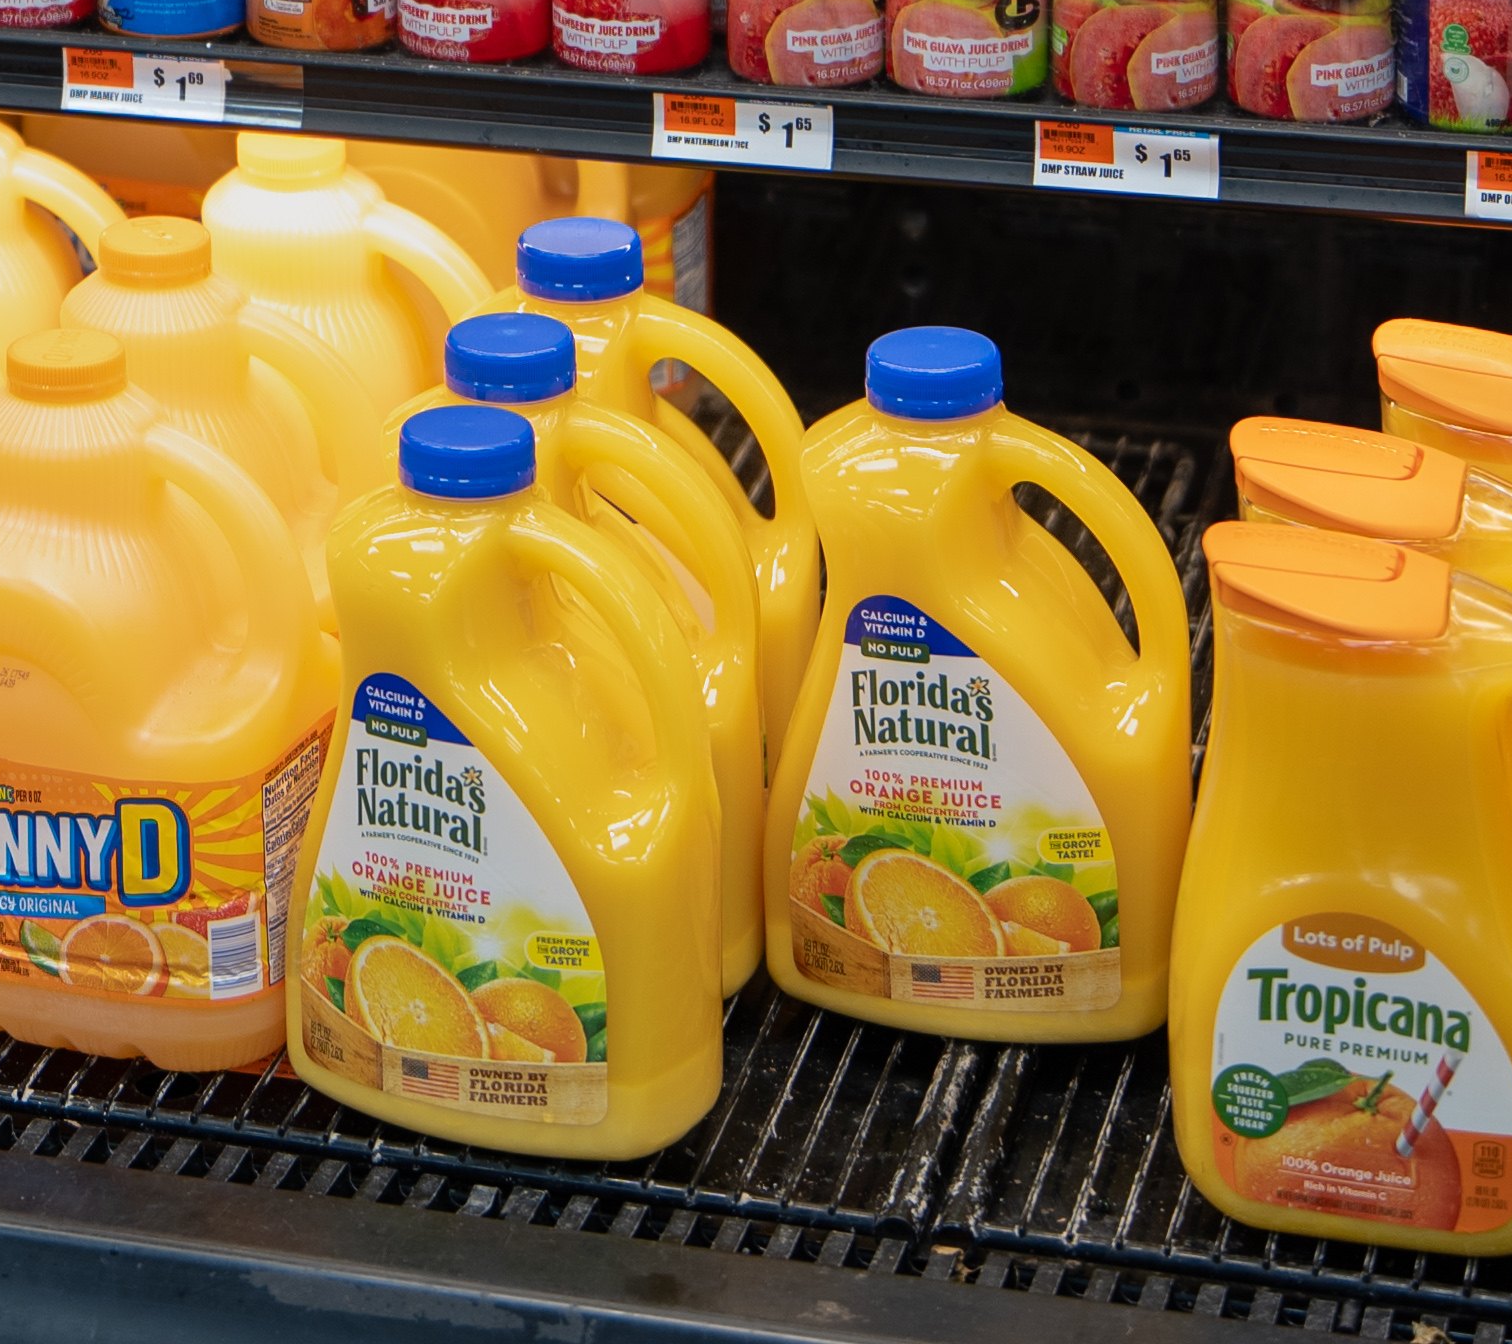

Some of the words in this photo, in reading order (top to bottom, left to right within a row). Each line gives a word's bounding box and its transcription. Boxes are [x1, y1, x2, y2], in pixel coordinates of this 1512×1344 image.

[70, 88, 84, 101] DMP
[88, 89, 118, 102] MAMEY
[121, 90, 143, 103] JUICE
[1481, 193, 1500, 206] DMP
[851, 667, 993, 722] Florida's
[855, 708, 989, 757] Natural
[849, 781, 923, 800] ORANGE
[929, 791, 1002, 808] JUICE
[1293, 924, 1335, 953] Lots
[1341, 931, 1363, 954] of
[1367, 937, 1415, 964] Pulp
[984, 966, 1038, 976] OWNED
[1044, 965, 1063, 976] BY
[985, 976, 1060, 986] FLORIDA
[985, 986, 1064, 998] FARMERS
[1247, 968, 1470, 1053] Tropicana
[1285, 1032, 1331, 1051] PURE
[1338, 1040, 1428, 1065] PREMIUM
